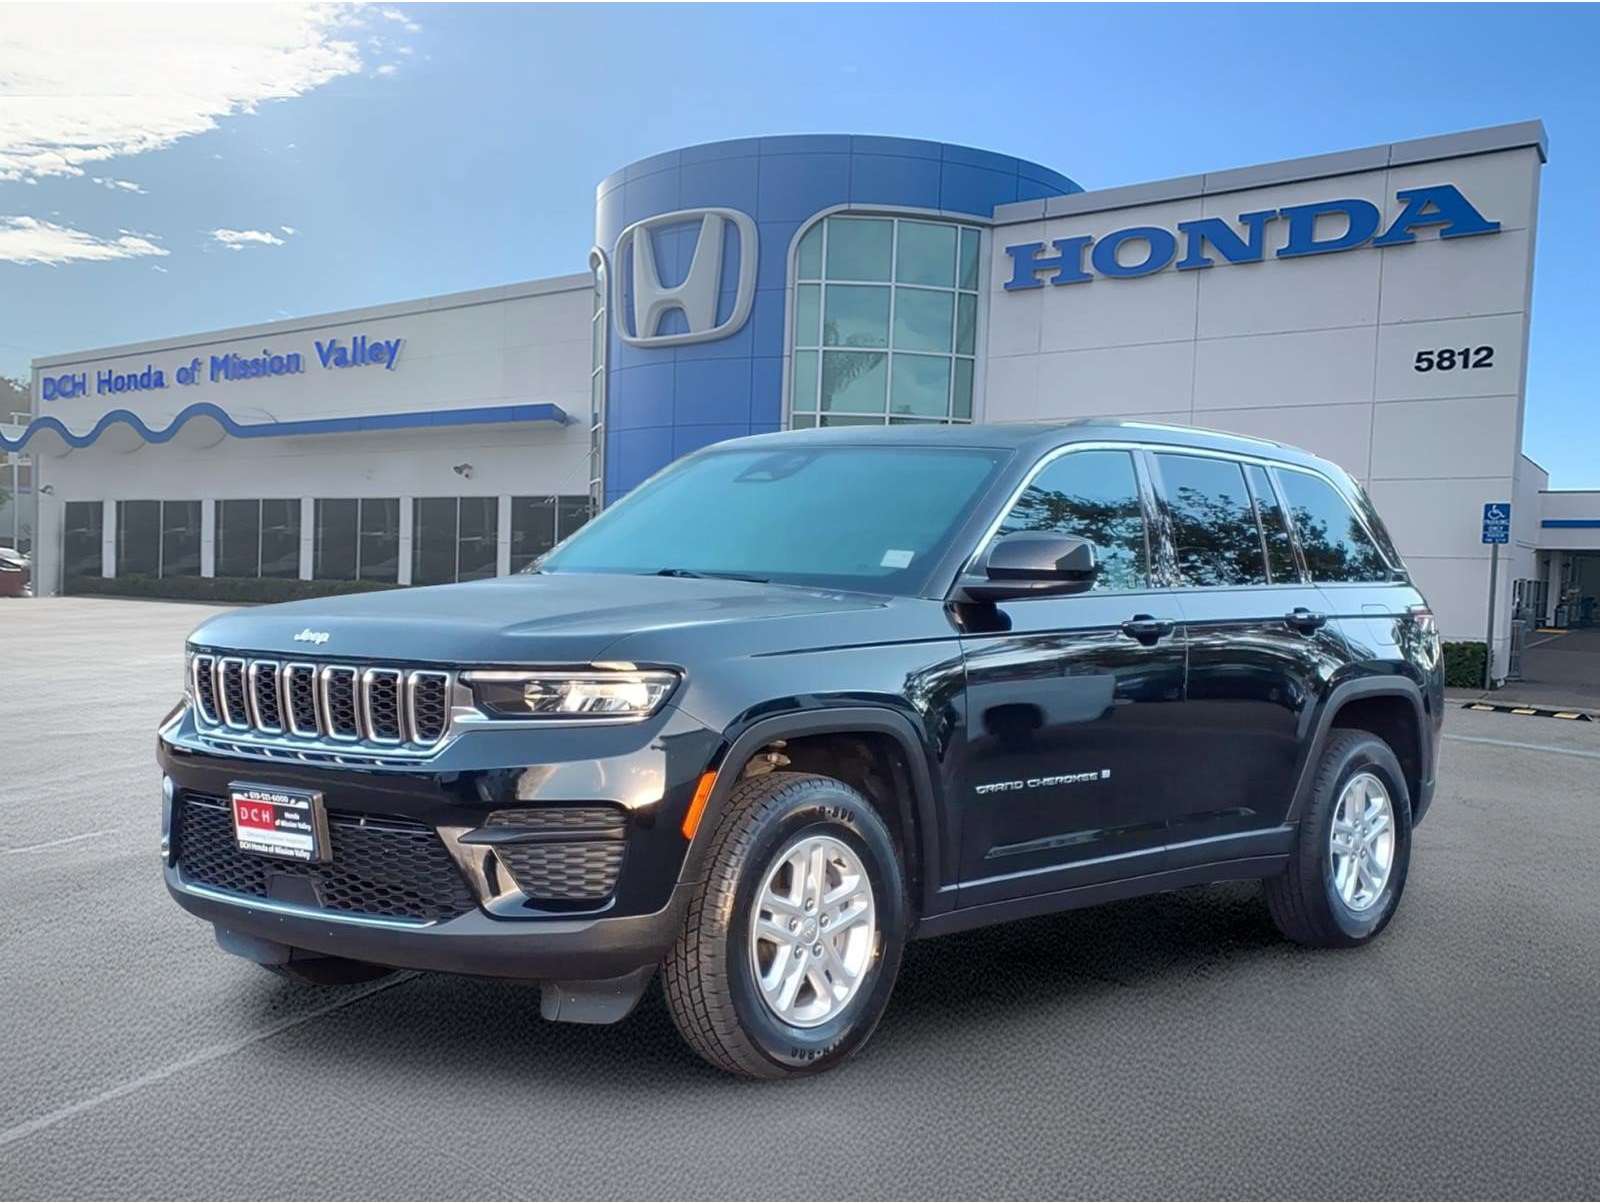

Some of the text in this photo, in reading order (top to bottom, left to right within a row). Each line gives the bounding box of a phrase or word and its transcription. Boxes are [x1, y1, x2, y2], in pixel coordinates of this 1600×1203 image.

[1004, 184, 1501, 291] HONDA
[42, 335, 402, 401] DCH Honda of Mission Valley
[1414, 346, 1494, 373] 5812
[294, 628, 330, 646] Jeep
[976, 772, 1098, 794] GRAND CHEROKEE
[240, 806, 271, 823] DCH
